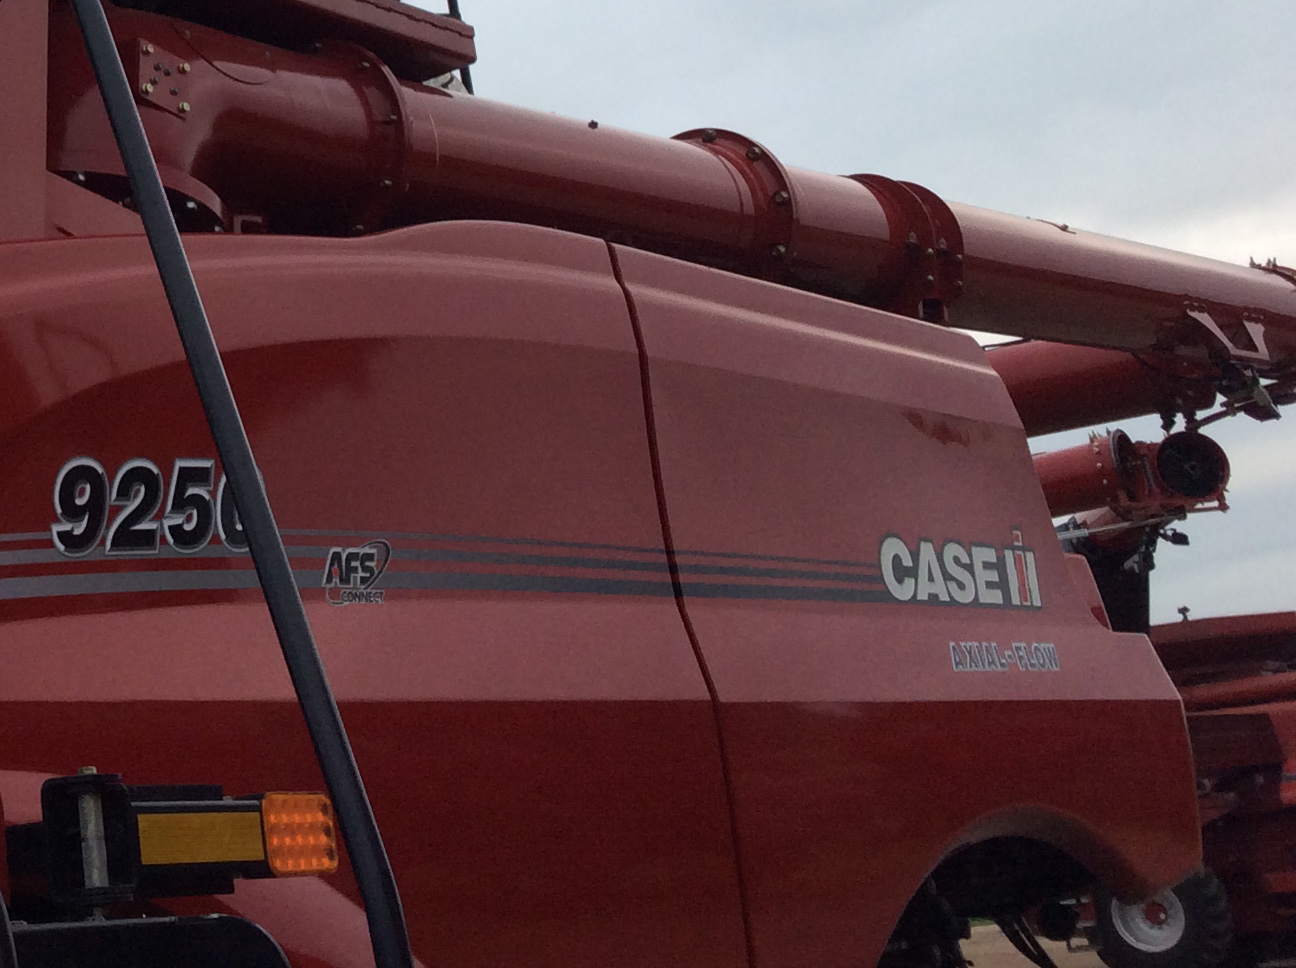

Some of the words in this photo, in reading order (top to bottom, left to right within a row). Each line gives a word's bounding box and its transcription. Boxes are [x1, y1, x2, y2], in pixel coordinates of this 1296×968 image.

[323, 547, 377, 588] AFS
[341, 590, 385, 604] CONNECT
[950, 642, 1060, 671] AXIAL-FLOW
